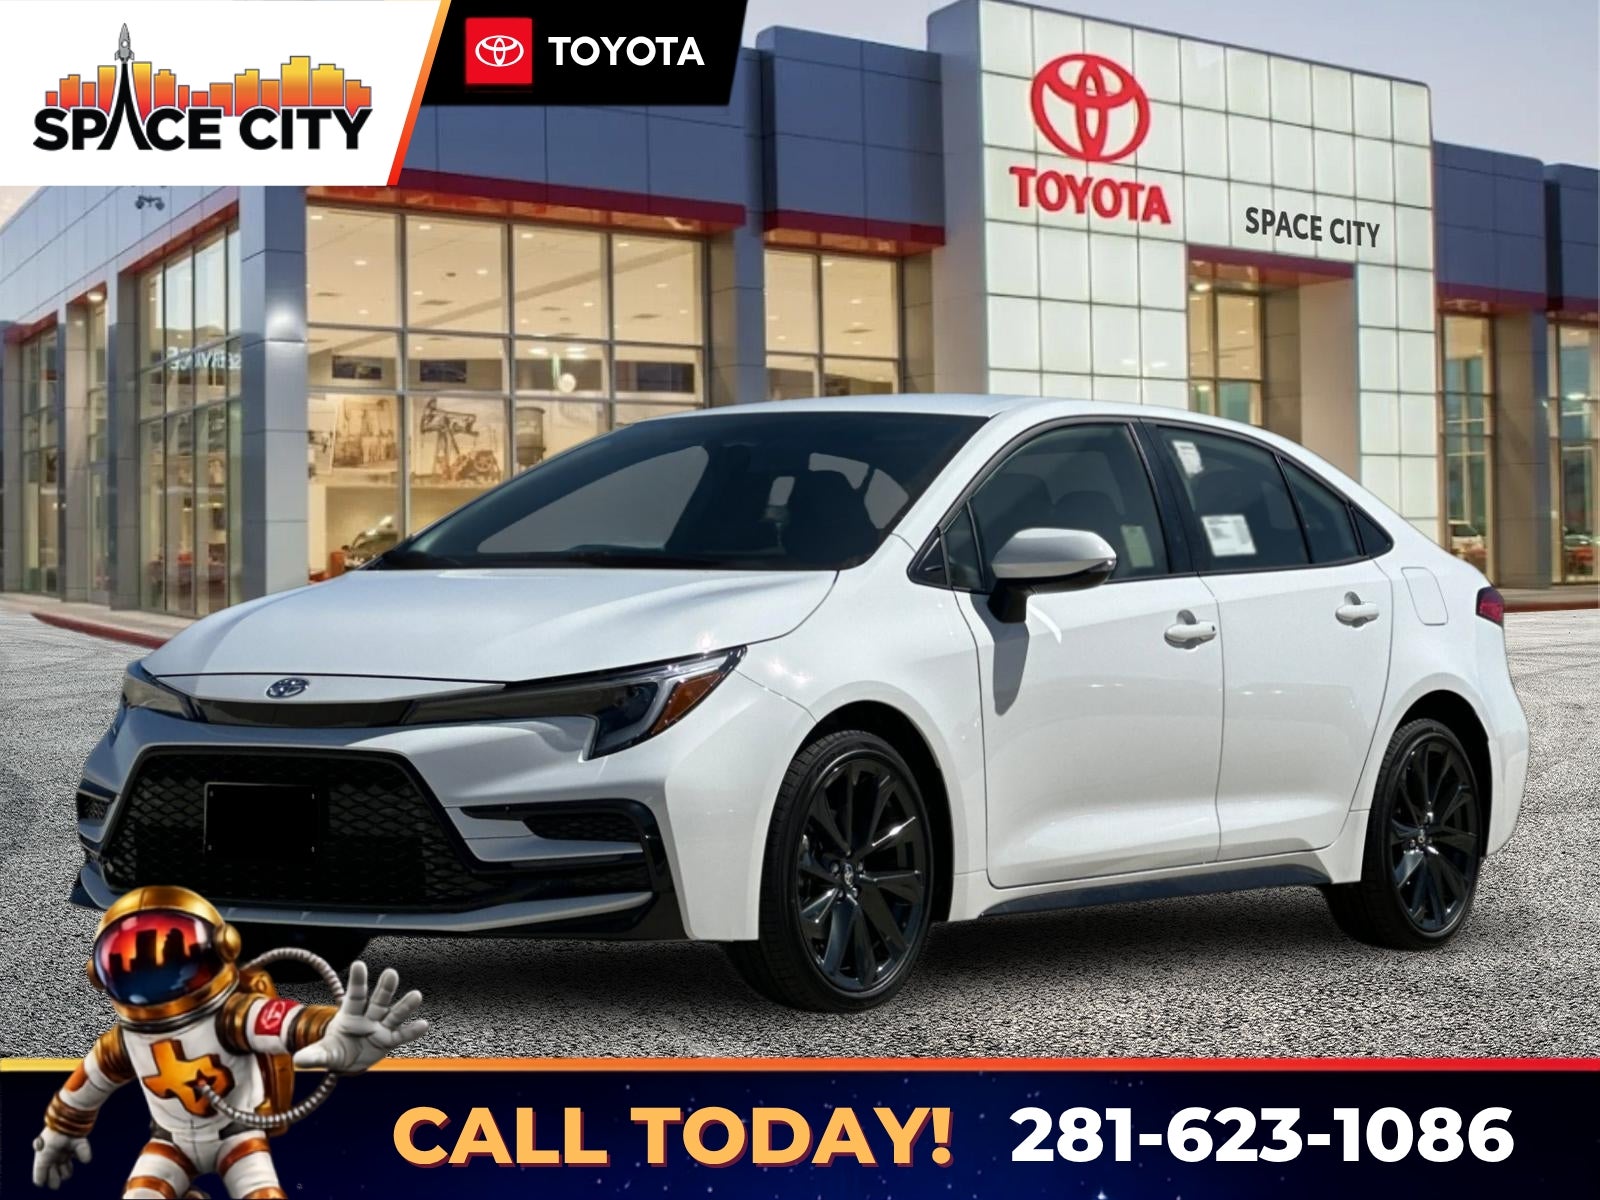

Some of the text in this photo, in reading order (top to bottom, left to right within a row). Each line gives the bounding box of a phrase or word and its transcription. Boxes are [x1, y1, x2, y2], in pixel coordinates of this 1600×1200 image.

[1009, 166, 1171, 225] TOYOTA
[1245, 206, 1381, 248] SPACE CITY
